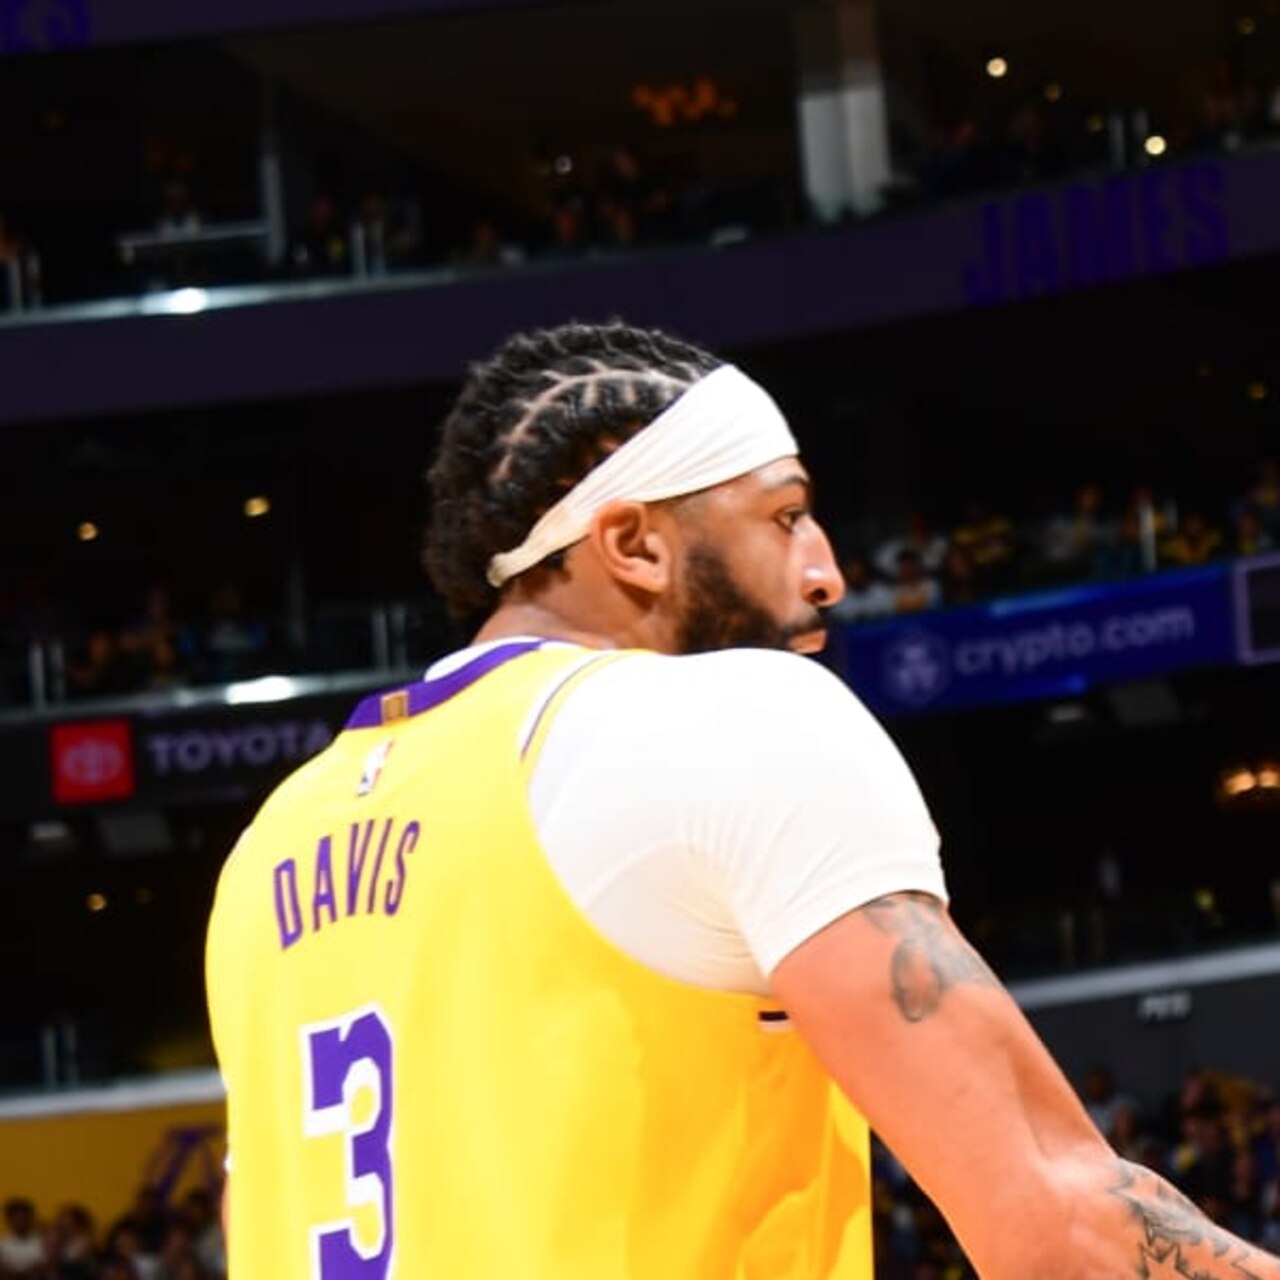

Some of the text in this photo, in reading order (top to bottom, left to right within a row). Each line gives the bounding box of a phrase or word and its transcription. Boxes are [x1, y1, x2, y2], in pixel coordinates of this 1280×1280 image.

[964, 160, 1230, 308] JAMES
[955, 606, 1196, 675] crypto.com
[148, 718, 335, 776] TOYOTA
[273, 818, 421, 951] DAVIS
